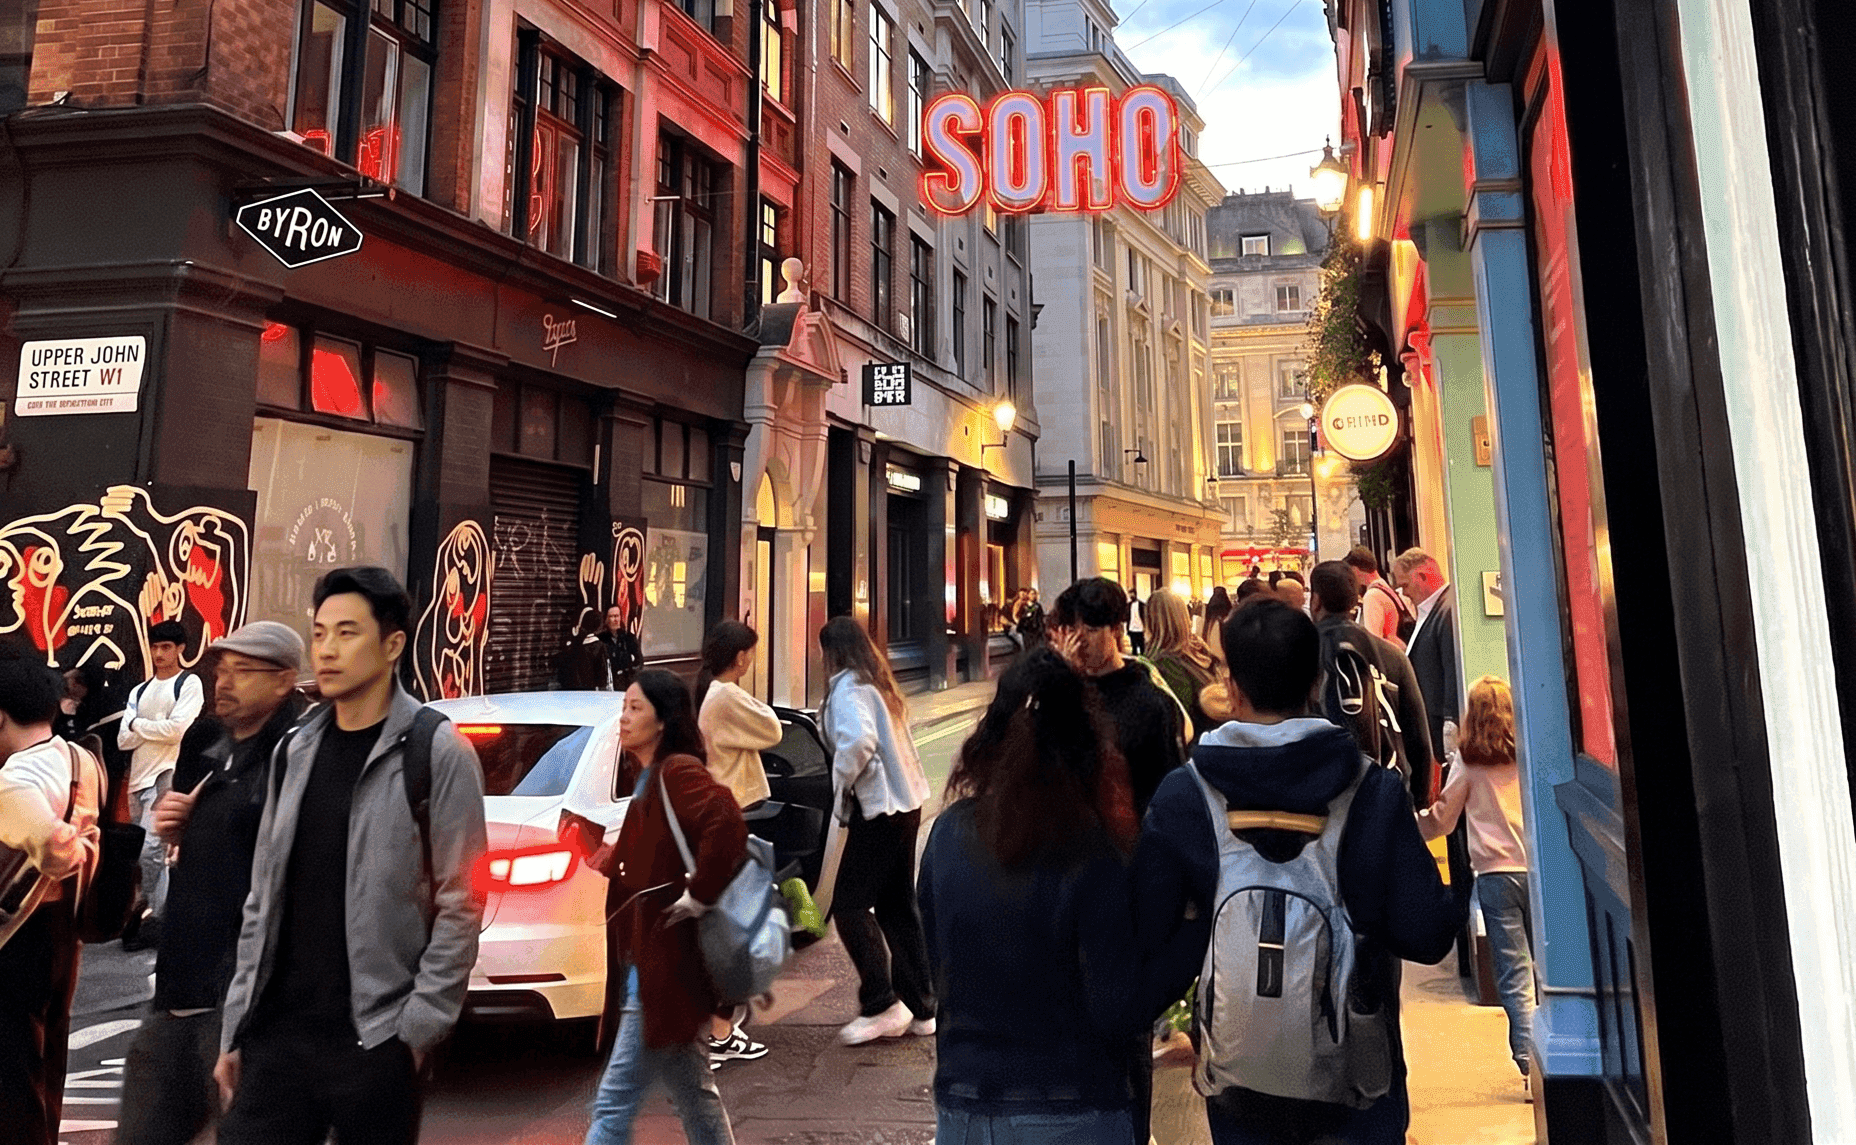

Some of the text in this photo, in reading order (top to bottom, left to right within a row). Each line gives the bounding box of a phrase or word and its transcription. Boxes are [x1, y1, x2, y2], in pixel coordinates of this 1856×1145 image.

[924, 86, 1178, 214] SOHO
[257, 206, 343, 251] BYRON
[31, 344, 139, 367] UPPER JOHN
[29, 367, 122, 389] STREET W1
